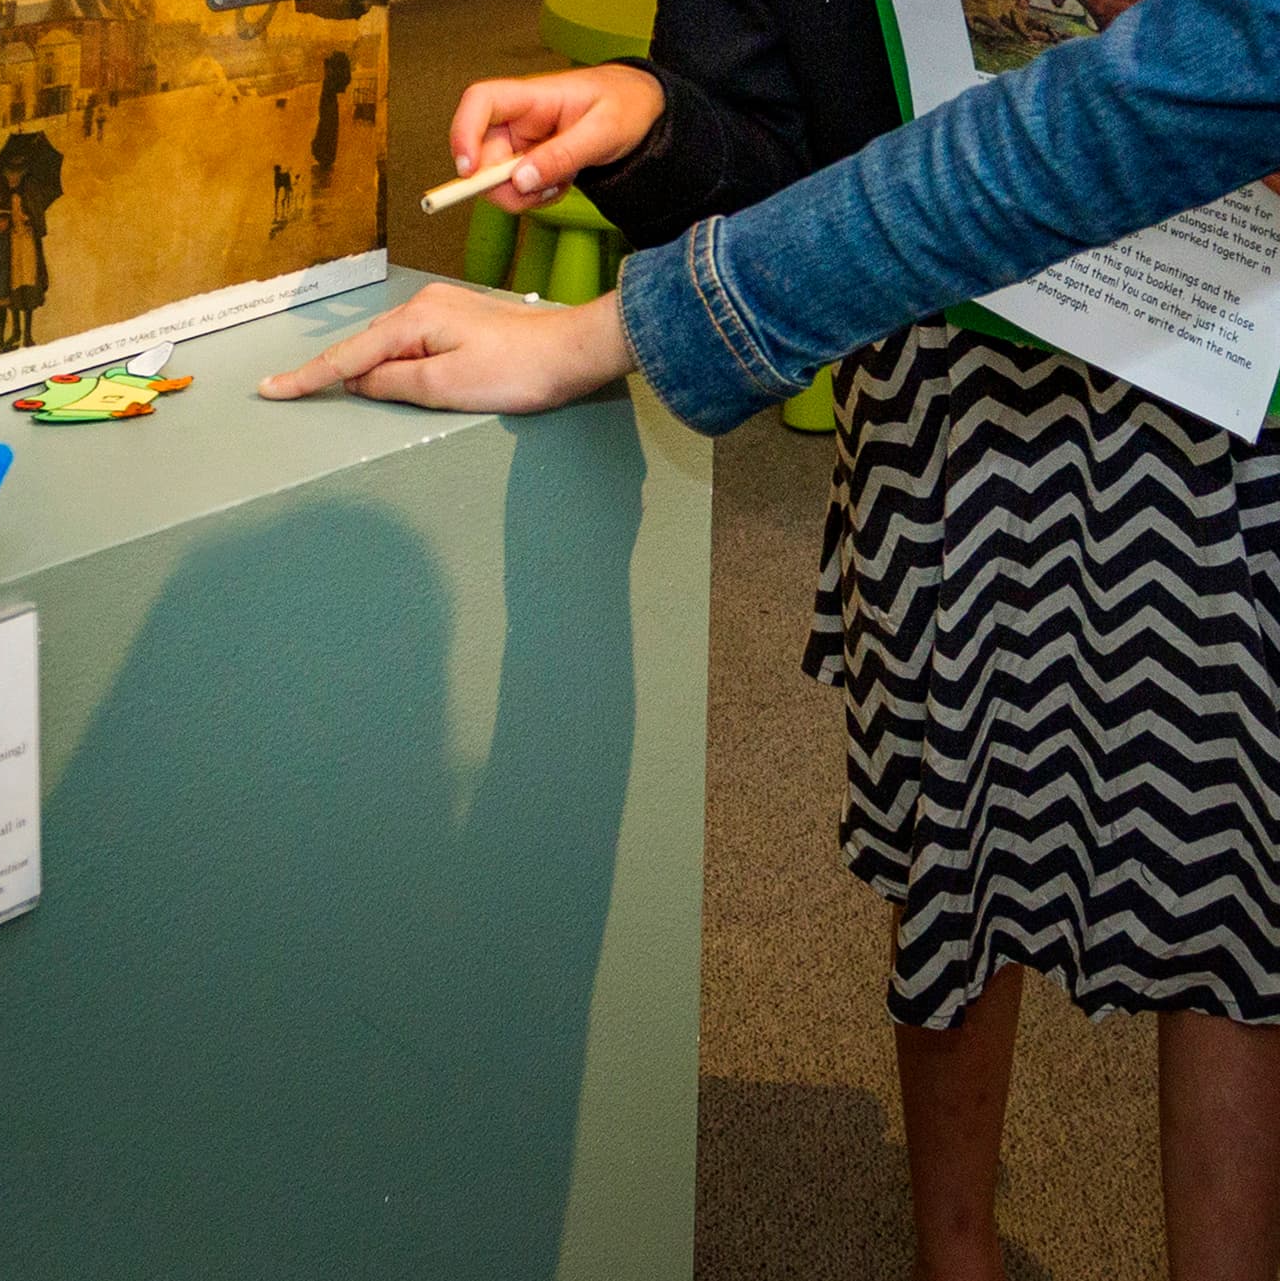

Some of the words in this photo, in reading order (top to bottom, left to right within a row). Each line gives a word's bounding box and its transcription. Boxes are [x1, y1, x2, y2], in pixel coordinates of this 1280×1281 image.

[1178, 214, 1230, 240] alongside
[1233, 231, 1263, 254] those
[1265, 247, 1278, 260] of
[1231, 213, 1248, 230] his
[1120, 245, 1133, 258] of
[1135, 249, 1153, 267] the
[1153, 259, 1200, 289] paintings
[1201, 280, 1222, 297] and
[1223, 288, 1241, 306] the
[1170, 226, 1210, 249] worked
[1212, 241, 1260, 270] together
[1261, 261, 1272, 276] in
[1069, 257, 1090, 275] find
[1121, 280, 1140, 298] You
[1140, 292, 1159, 308] can
[1160, 301, 1193, 322] either
[1192, 316, 1216, 333] just
[1219, 325, 1240, 344] tick
[1103, 254, 1122, 272] this
[1123, 264, 1145, 282] quiz
[1191, 293, 1218, 315] Have
[1228, 311, 1256, 332] close
[1064, 275, 1103, 301] spotted
[1133, 308, 1146, 319] or
[1147, 314, 1176, 334] write
[1176, 326, 1204, 348] down
[1206, 339, 1224, 357] the
[1224, 349, 1253, 371] name
[63, 351, 84, 364] HER
